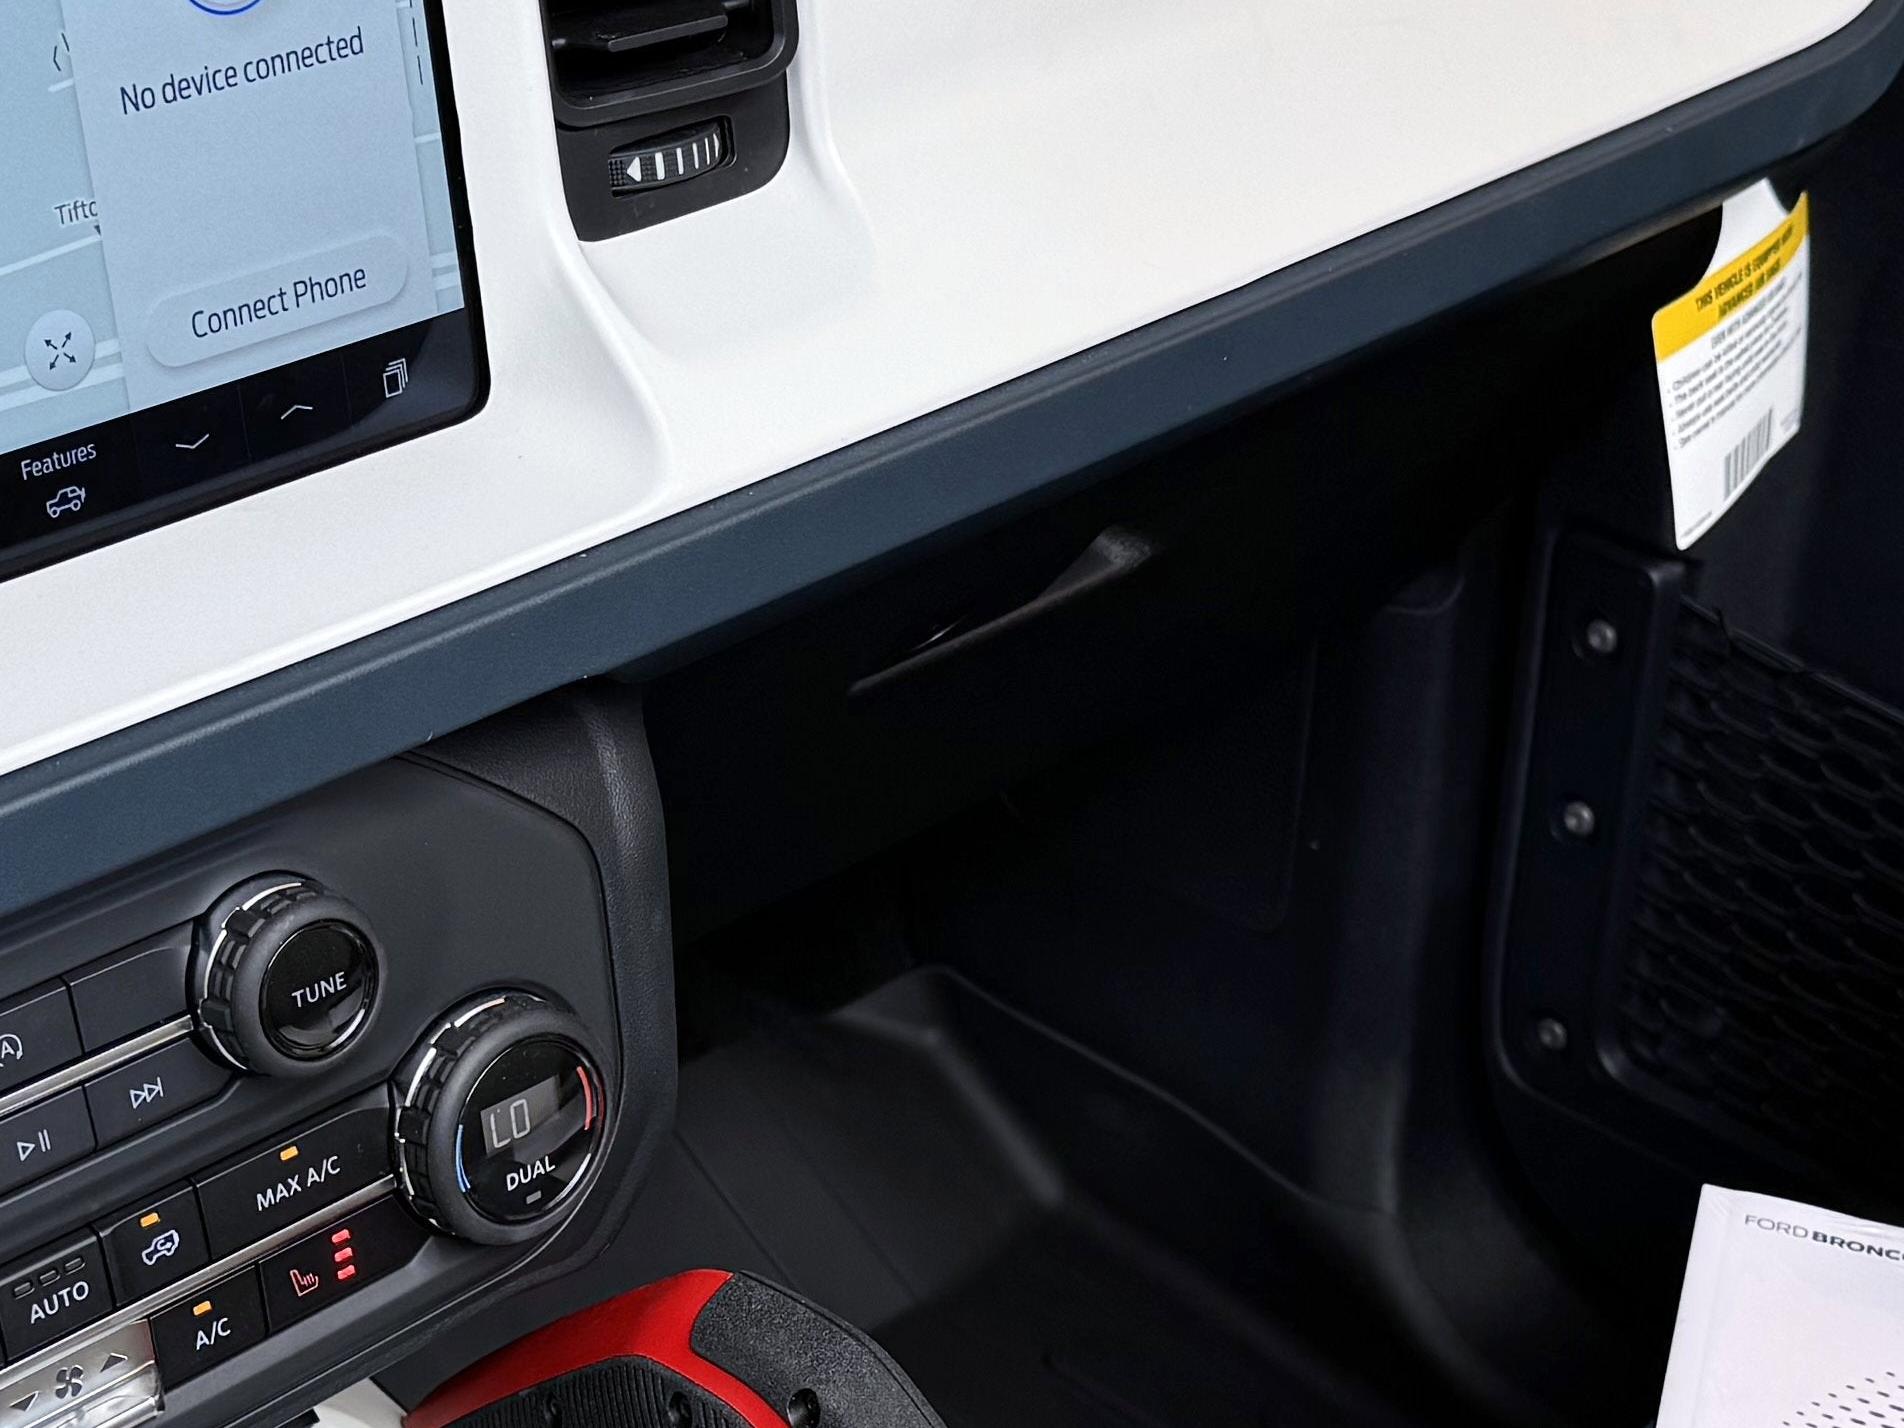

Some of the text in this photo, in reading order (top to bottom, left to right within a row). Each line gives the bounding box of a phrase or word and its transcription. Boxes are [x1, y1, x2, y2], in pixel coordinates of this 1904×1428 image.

[119, 27, 365, 116] No device connected
[190, 263, 368, 341] Connect Phone
[20, 441, 97, 482] Features
[289, 970, 348, 1012] TUNE
[254, 1154, 342, 1213] MAX A/C
[504, 1155, 556, 1193] DUAL
[1745, 1214, 1809, 1239] FORD
[28, 1279, 91, 1327] AUTO
[193, 1314, 232, 1351] A/C
